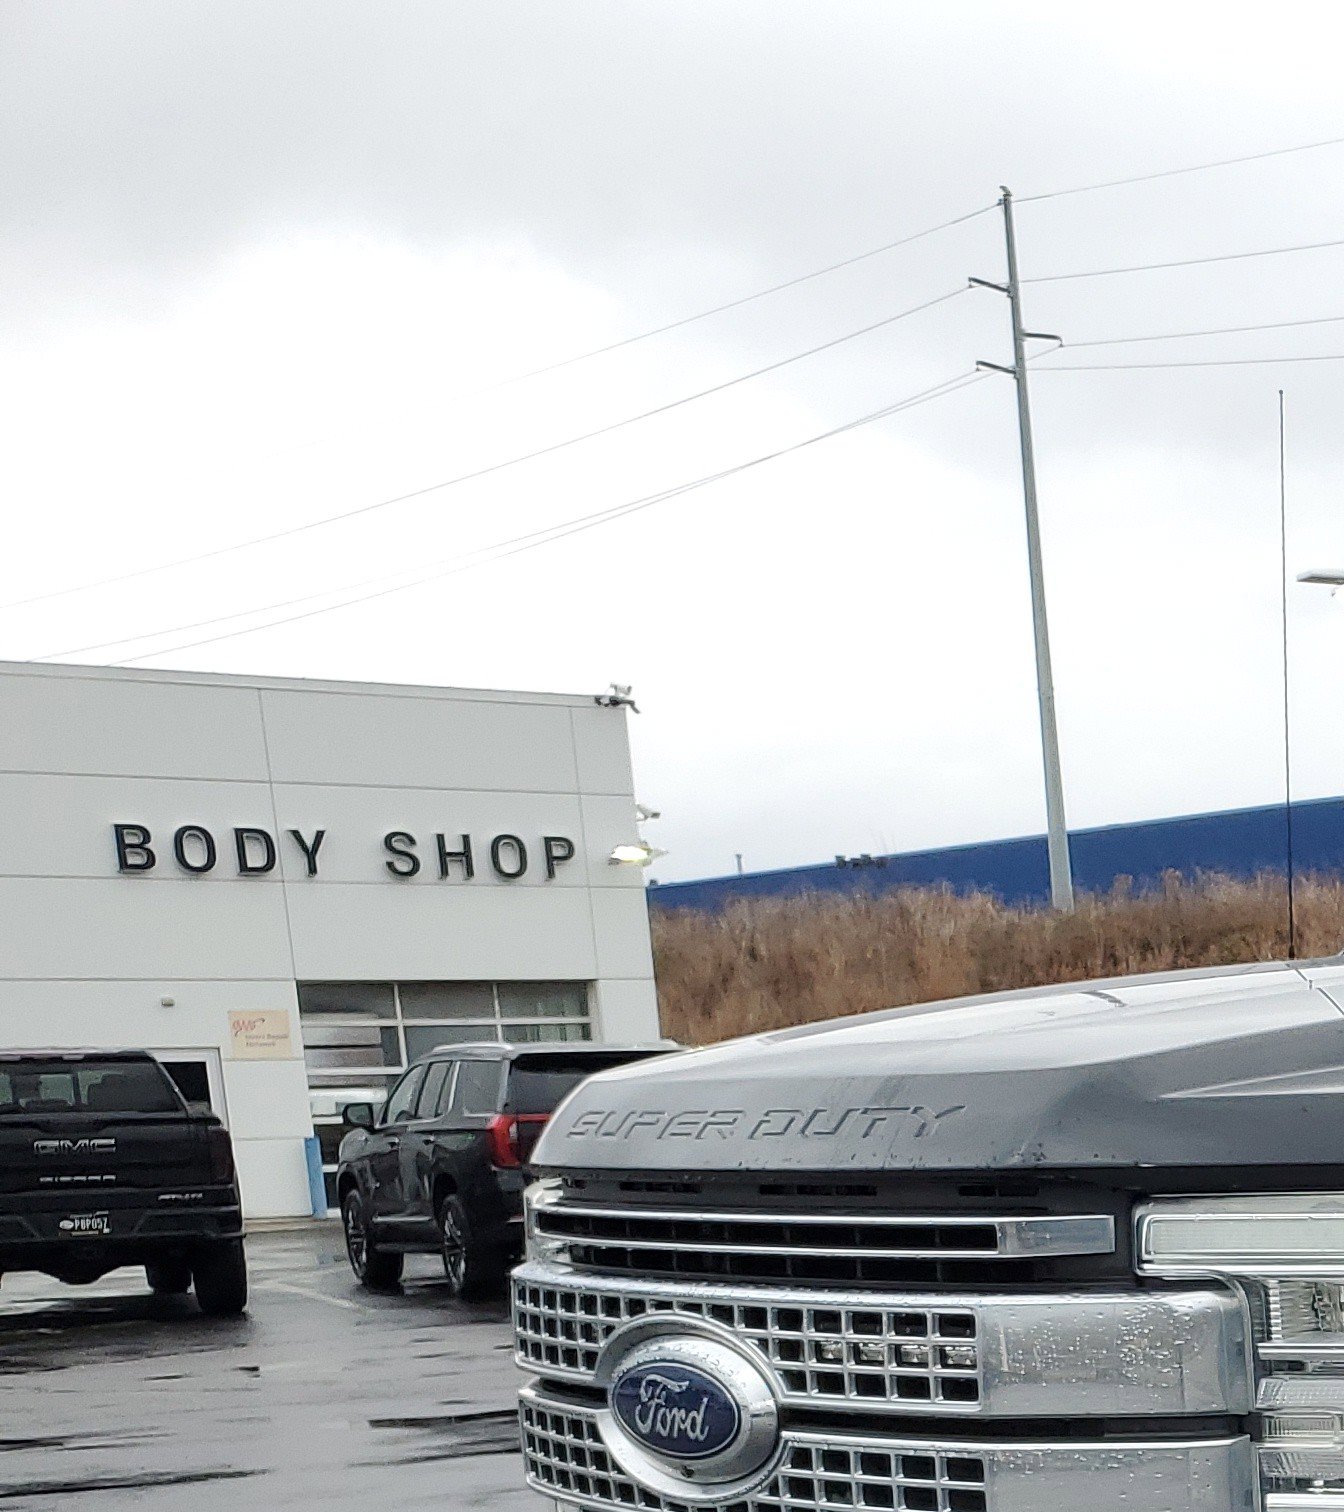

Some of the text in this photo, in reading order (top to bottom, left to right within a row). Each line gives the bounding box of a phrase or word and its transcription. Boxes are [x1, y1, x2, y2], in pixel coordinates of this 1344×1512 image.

[113, 823, 575, 881] BODY SHOP
[34, 1138, 116, 1153] GMC
[567, 1105, 967, 1140] SUPER DUTY
[635, 1373, 709, 1442] Ford
